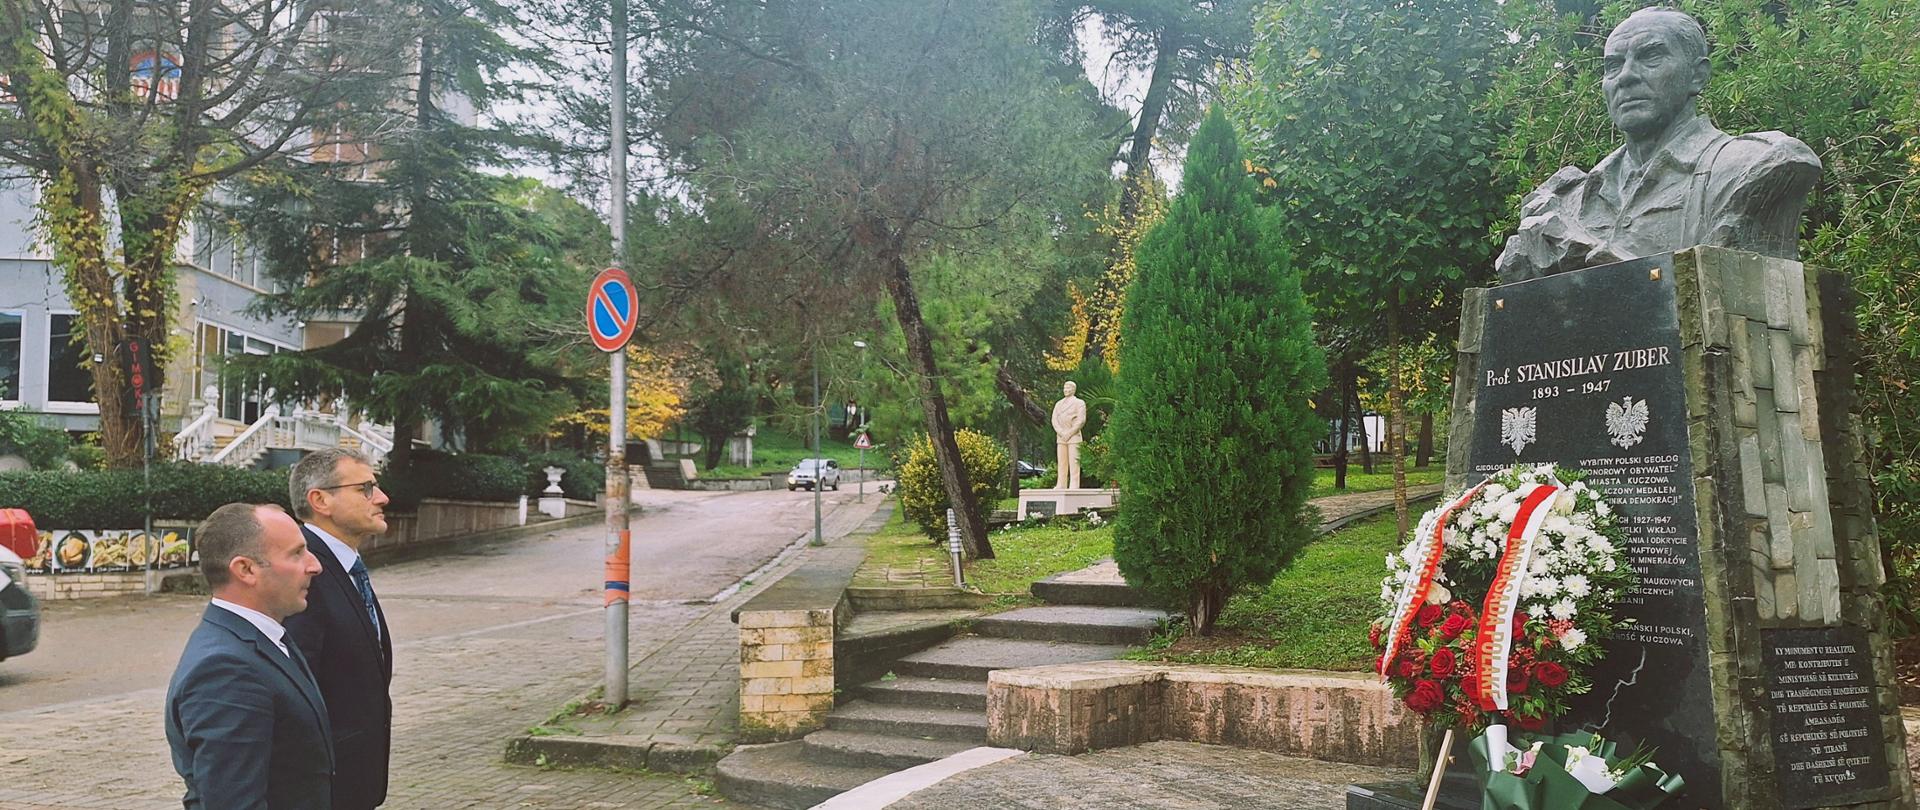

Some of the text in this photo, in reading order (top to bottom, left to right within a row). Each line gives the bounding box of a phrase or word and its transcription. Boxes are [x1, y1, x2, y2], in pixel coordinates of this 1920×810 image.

[1486, 369, 1511, 387] Prof.
[1612, 346, 1671, 371] ZUBER
[1532, 386, 1560, 400] 1893
[1582, 380, 1612, 395] 1947
[1579, 454, 1678, 466] WYBITNY POLSKI GEOLOG
[1587, 467, 1626, 475] ONOROWY
[1588, 475, 1669, 485] MIASTA KUCZOWA
[1633, 516, 1671, 524] 1927-1947
[1415, 521, 1440, 577] STANIS
[1631, 547, 1672, 556] NAFTOWEJ
[1638, 554, 1686, 565] MINERAŁÓW
[1643, 577, 1693, 586] NAUKOWYCH
[1480, 537, 1529, 702] AMBASADA POLAKE
[1660, 625, 1693, 637] POLSKI,
[1640, 635, 1683, 645] KUCZOWA
[1775, 647, 1784, 655] KY
